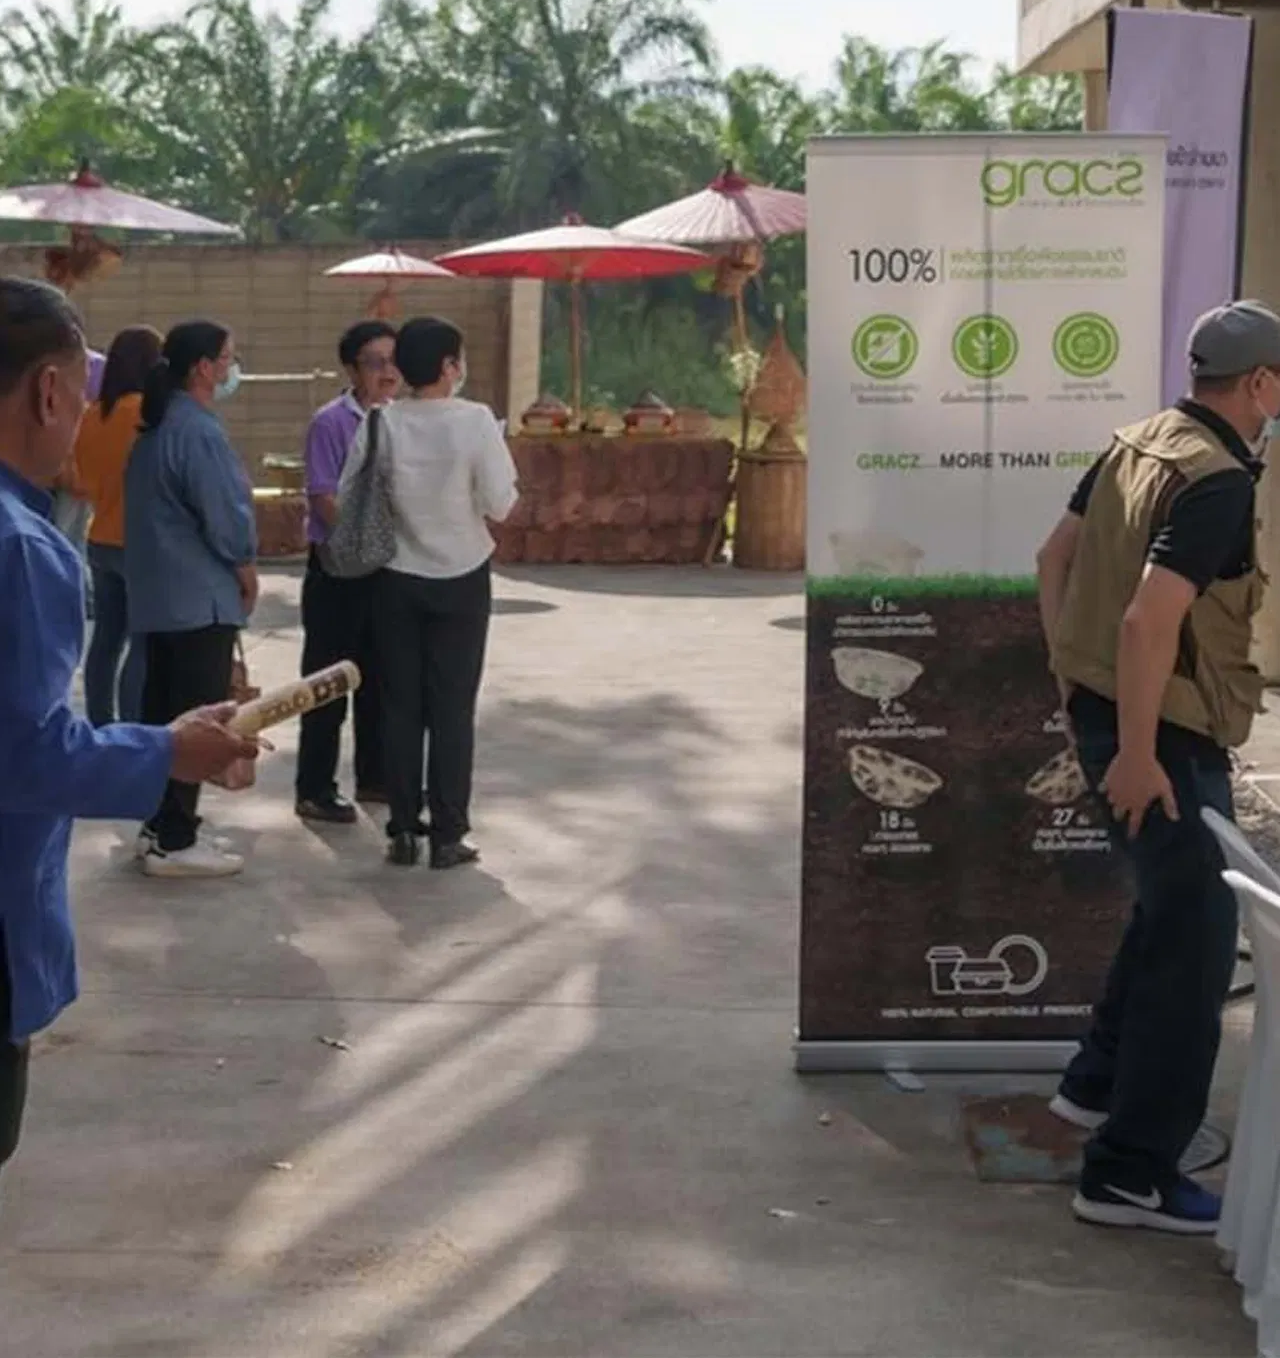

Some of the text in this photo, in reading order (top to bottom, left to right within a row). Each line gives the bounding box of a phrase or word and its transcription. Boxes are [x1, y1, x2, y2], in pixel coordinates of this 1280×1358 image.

[849, 248, 937, 283] 100%
[939, 451, 994, 470] MORE
[998, 450, 1050, 470] THAN
[879, 810, 900, 829] 18
[1052, 807, 1075, 827] 27
